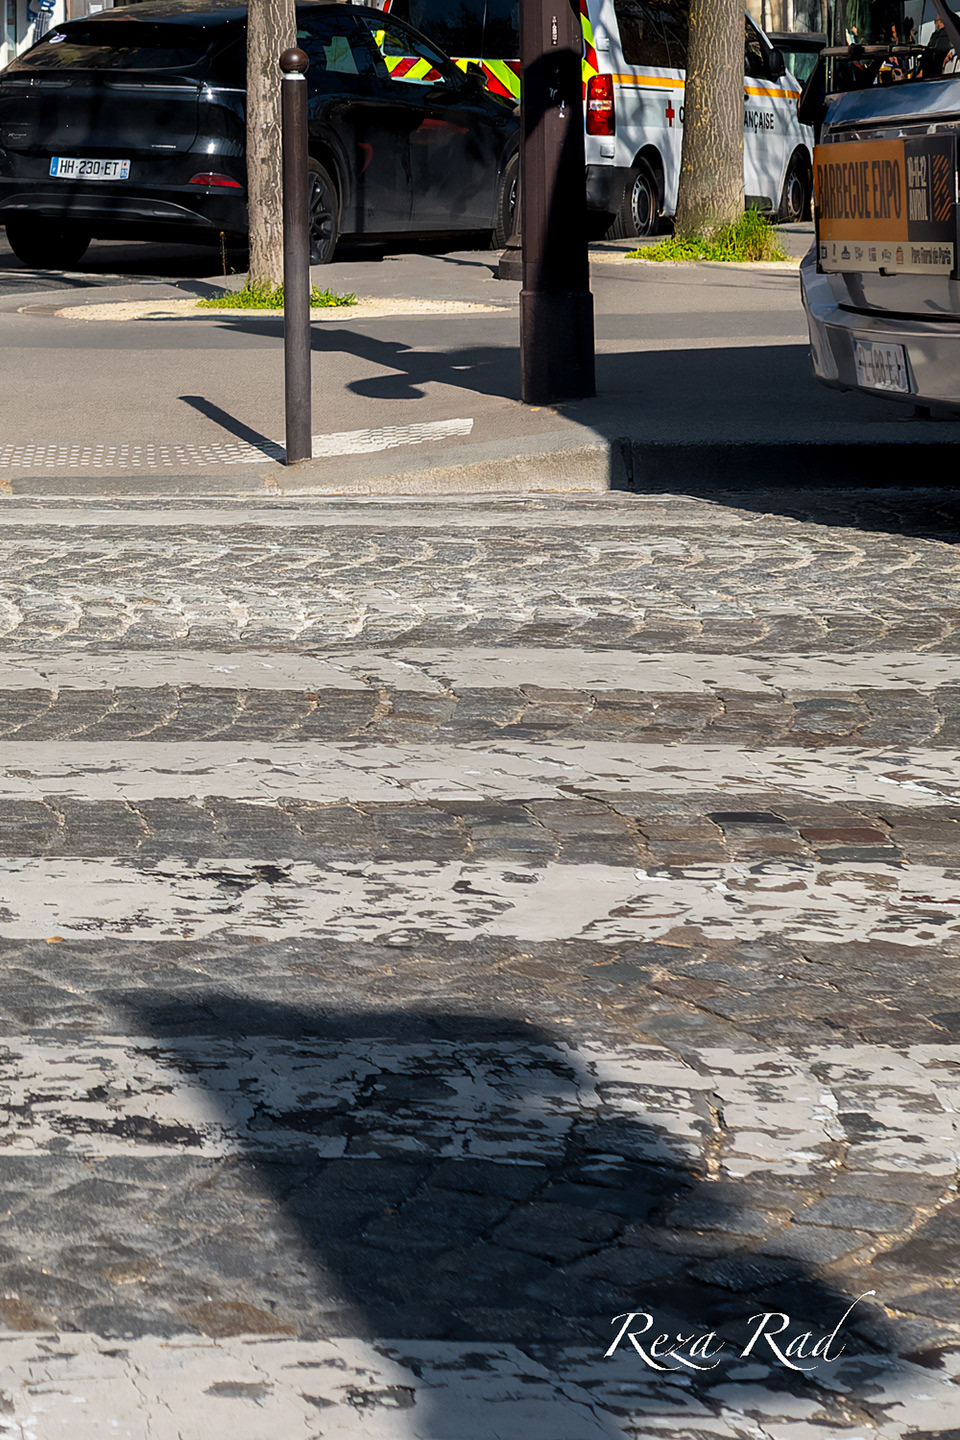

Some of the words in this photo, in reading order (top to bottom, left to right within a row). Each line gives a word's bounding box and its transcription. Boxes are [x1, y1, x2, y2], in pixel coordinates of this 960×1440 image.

[744, 110, 774, 133] ANÇAISE
[59, 160, 119, 175] HH-230-ET
[817, 161, 871, 219] BARBECUE
[872, 159, 902, 219] EXPO
